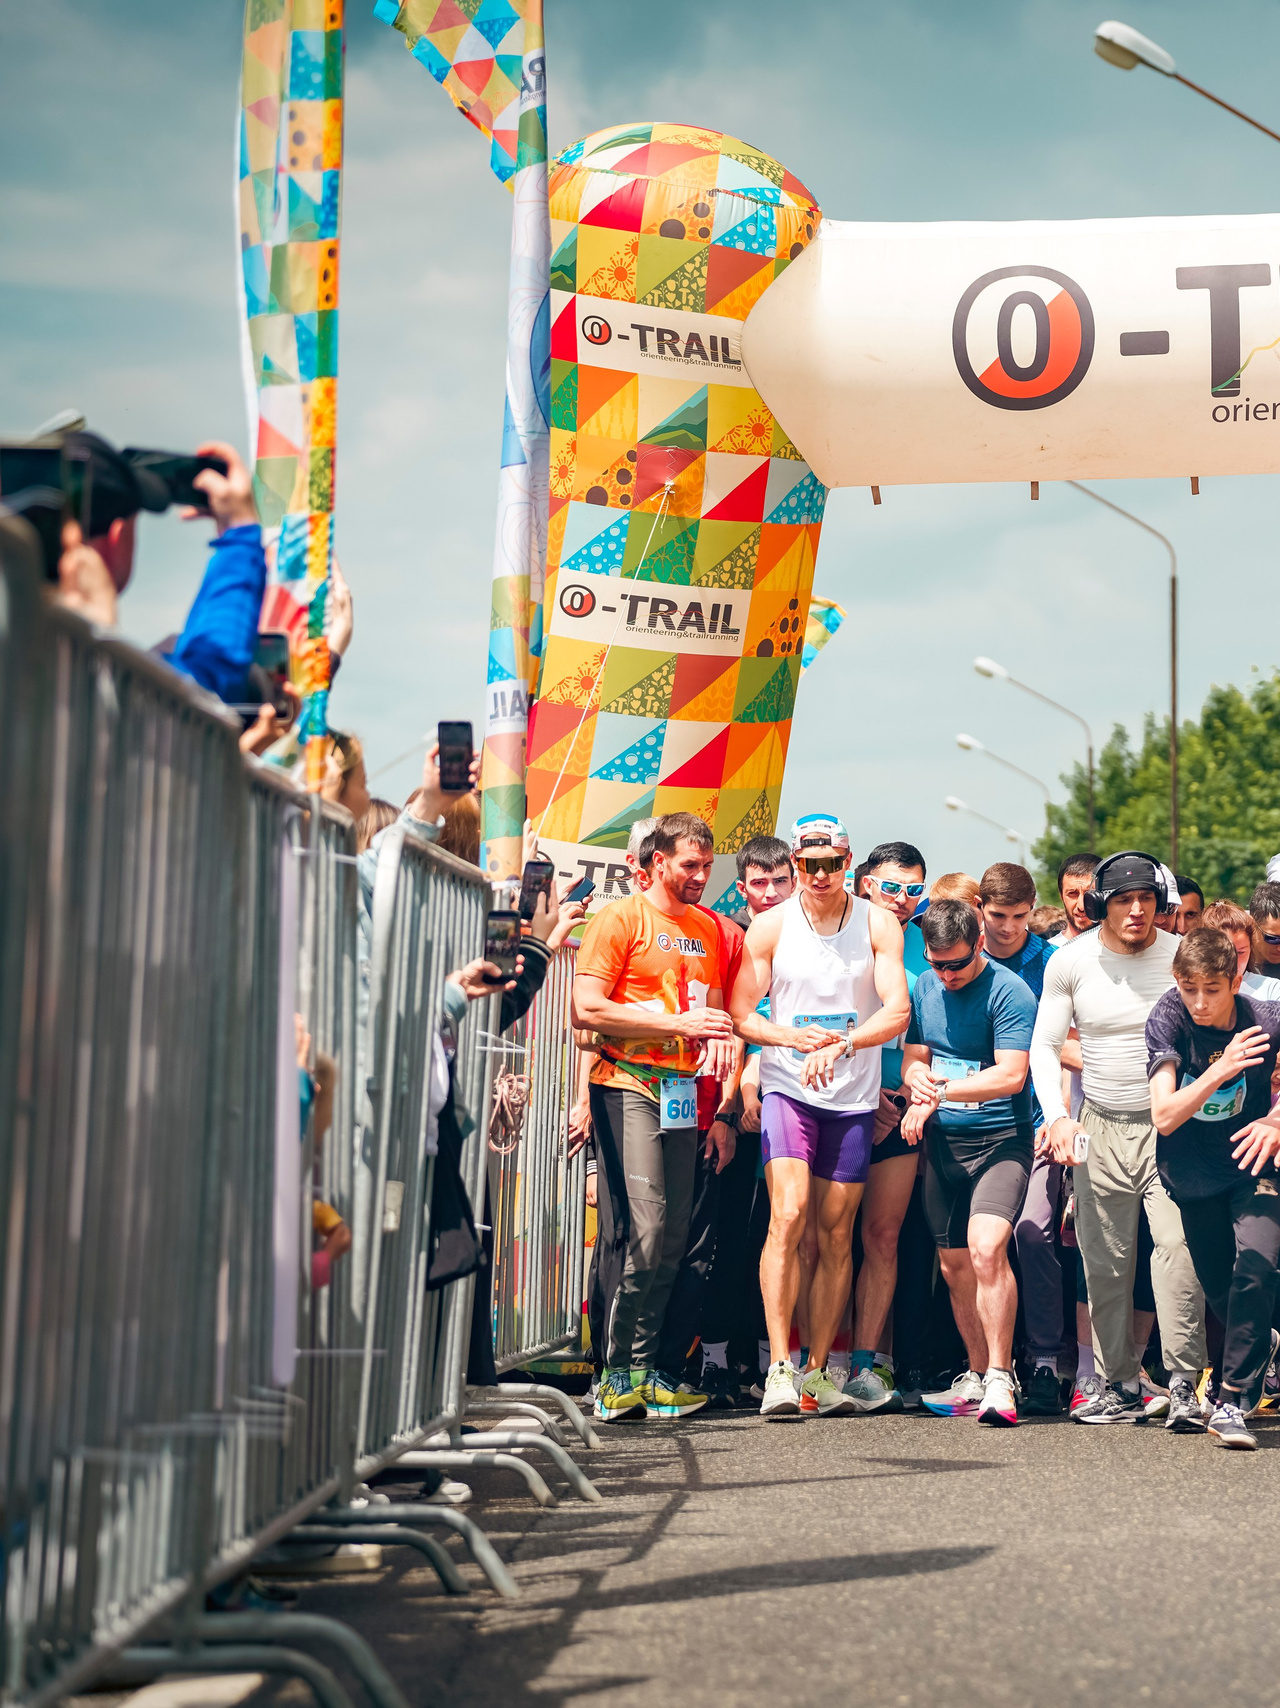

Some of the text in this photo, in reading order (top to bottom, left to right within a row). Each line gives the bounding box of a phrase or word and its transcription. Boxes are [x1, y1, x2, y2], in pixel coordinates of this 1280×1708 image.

[640, 352, 742, 372] orienteering&trailrunning
[625, 625, 739, 642] orienteering&trailrunning
[1197, 1098, 1236, 1116] 64
